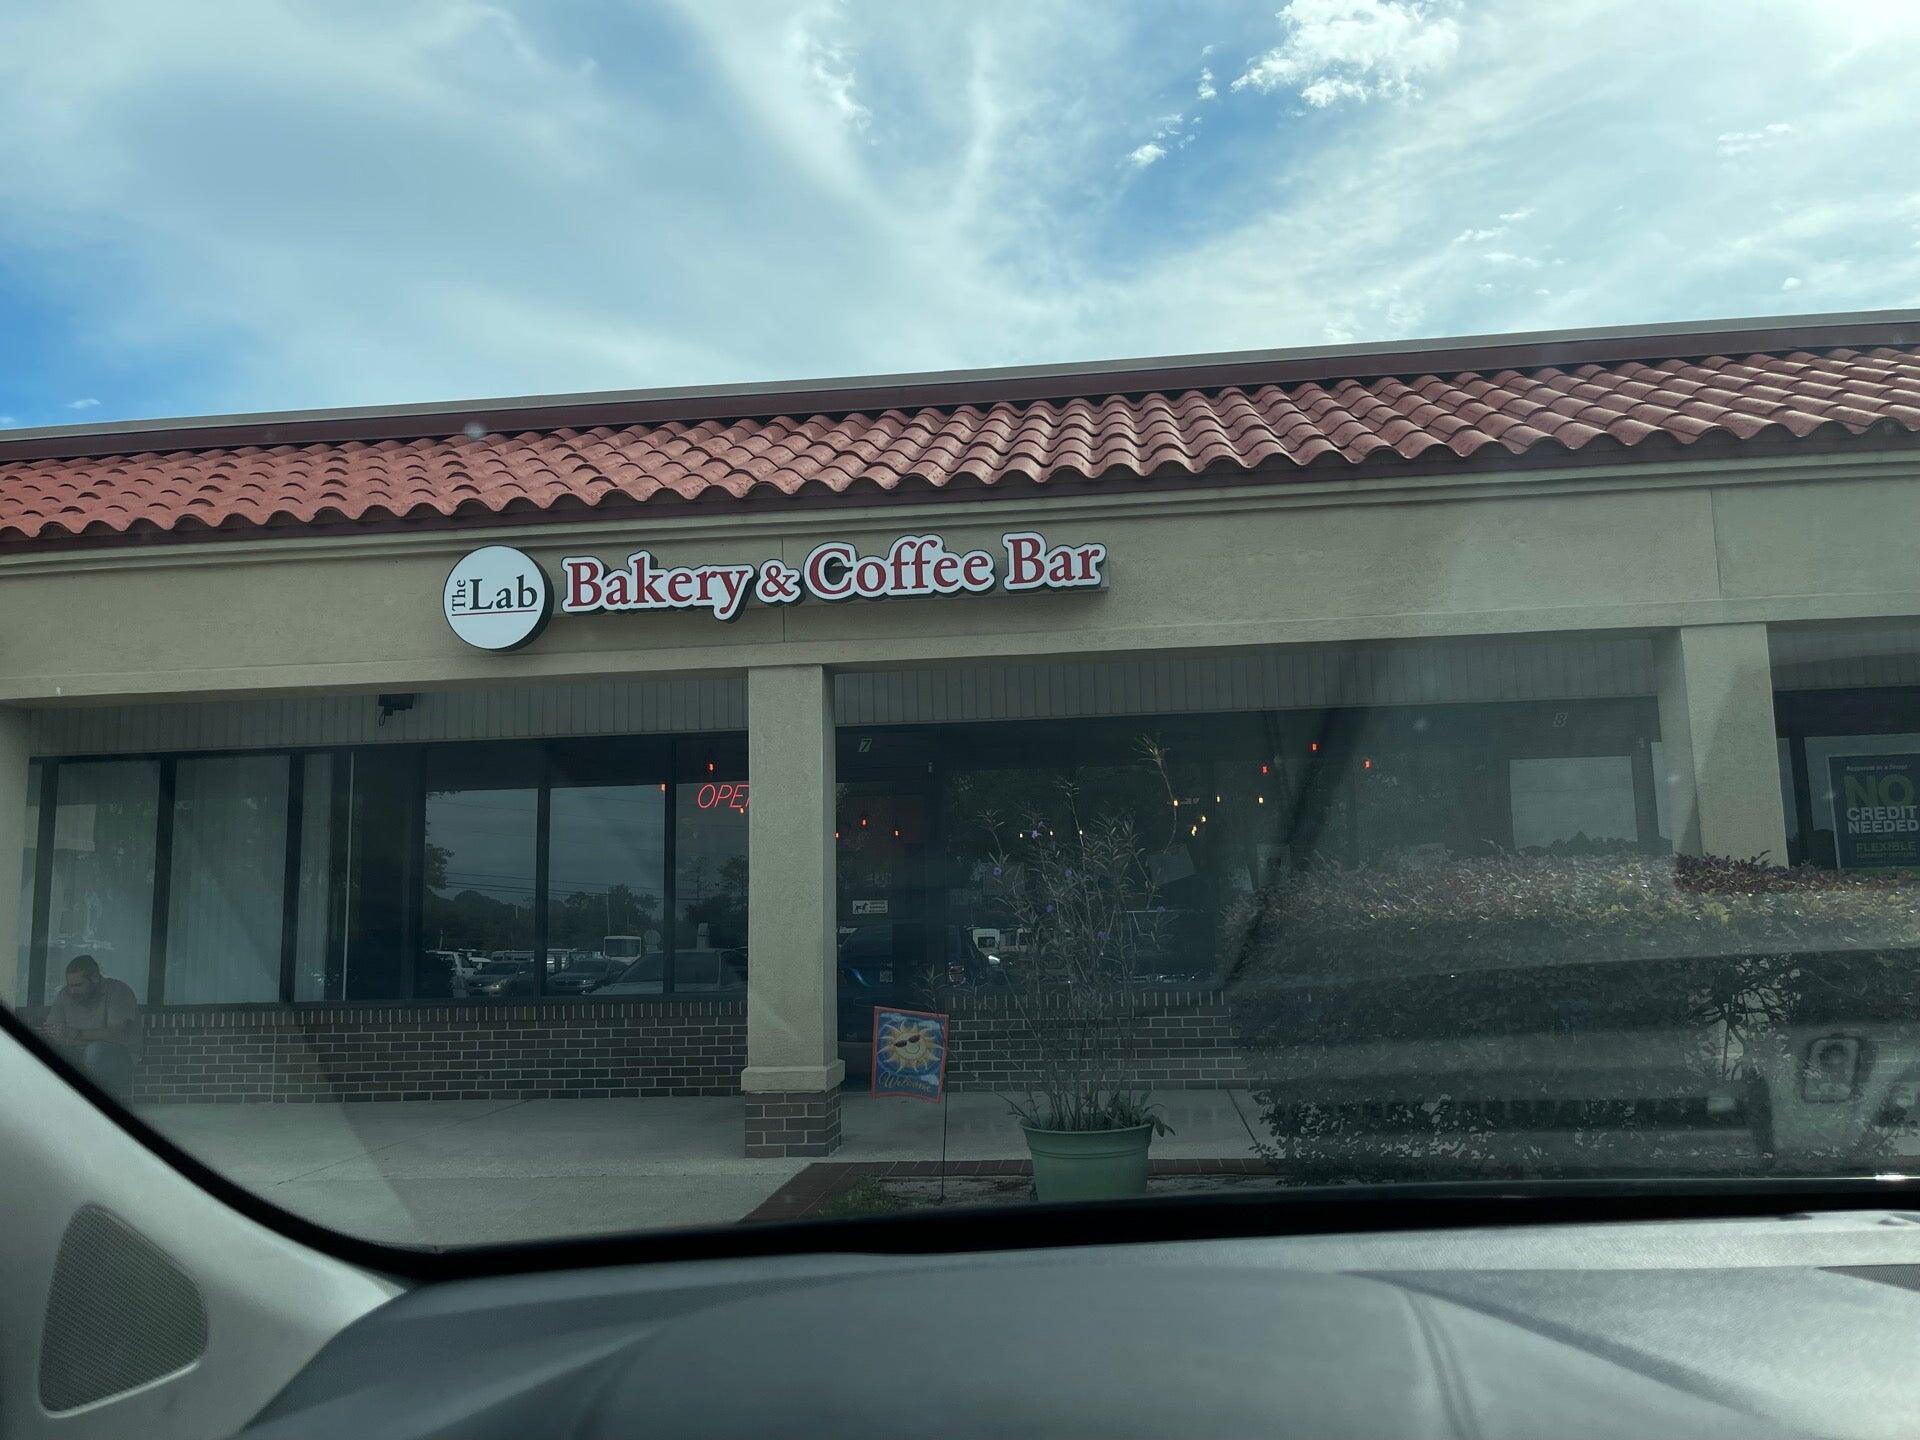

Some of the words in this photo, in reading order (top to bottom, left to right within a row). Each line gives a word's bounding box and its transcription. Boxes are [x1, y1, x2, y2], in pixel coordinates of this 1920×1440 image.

[566, 556, 749, 614] Bakery
[761, 564, 796, 597] &
[809, 540, 990, 595] Coffee
[1007, 537, 1101, 585] Bar
[451, 578, 467, 611] The
[469, 574, 538, 611] Lab
[859, 739, 872, 752] 7
[697, 784, 751, 809] OPE
[1844, 774, 1914, 806] NO
[1847, 805, 1917, 821] CREDIT
[1848, 819, 1919, 834] NEEDED
